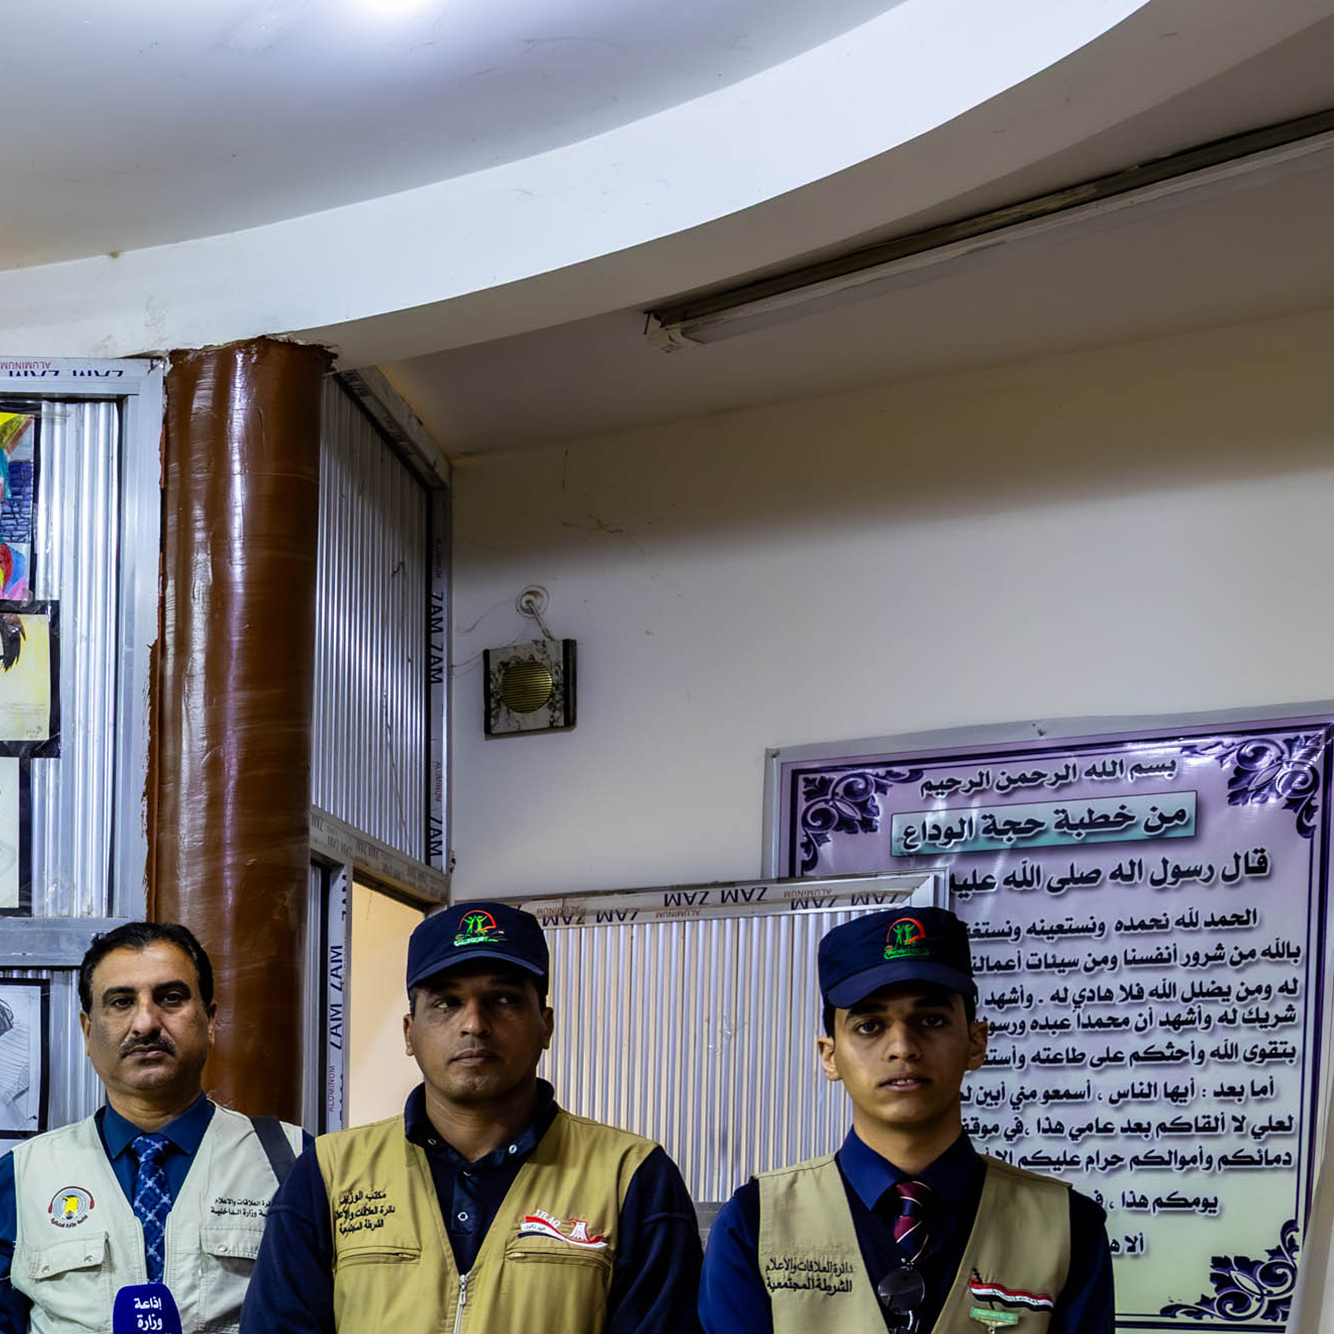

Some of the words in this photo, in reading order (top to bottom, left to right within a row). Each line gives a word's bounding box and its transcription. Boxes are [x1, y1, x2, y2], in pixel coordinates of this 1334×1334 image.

[994, 763, 1077, 792] الرحمن
[1130, 757, 1177, 779] بسم
[919, 771, 991, 798] الرحيم
[982, 814, 1046, 842] حجة
[1054, 805, 1136, 840] خطبة
[1144, 807, 1186, 832] من
[901, 818, 976, 849] الوداع
[1150, 858, 1214, 886] رسول
[1222, 848, 1270, 882] قال
[1047, 863, 1101, 893] صلى
[664, 892, 709, 908] ZAM
[721, 887, 769, 904] ZAM
[1026, 916, 1105, 937] ونستعينه
[1115, 913, 1169, 934] نحمده
[1204, 909, 1256, 931] الحمد
[1026, 953, 1079, 973] سيئات
[1084, 953, 1117, 972] ومن
[1124, 943, 1177, 969] أنفسنا
[1181, 943, 1226, 967] شرور
[1230, 946, 1256, 966] من
[1050, 987, 1068, 1003] له
[1119, 983, 1144, 1004] فلا
[1181, 981, 1231, 1003] يضلل
[1236, 982, 1272, 1002] ومن
[1278, 978, 1298, 994] له
[983, 985, 1033, 1009] وأشهد
[1072, 986, 1113, 1009] هادي
[1122, 1191, 1148, 1208] هذا
[1153, 1192, 1218, 1213] يومكم
[815, 1277, 853, 1296] الشرطة
[133, 1296, 162, 1310] إذاعة
[136, 1313, 163, 1331] وزارة
